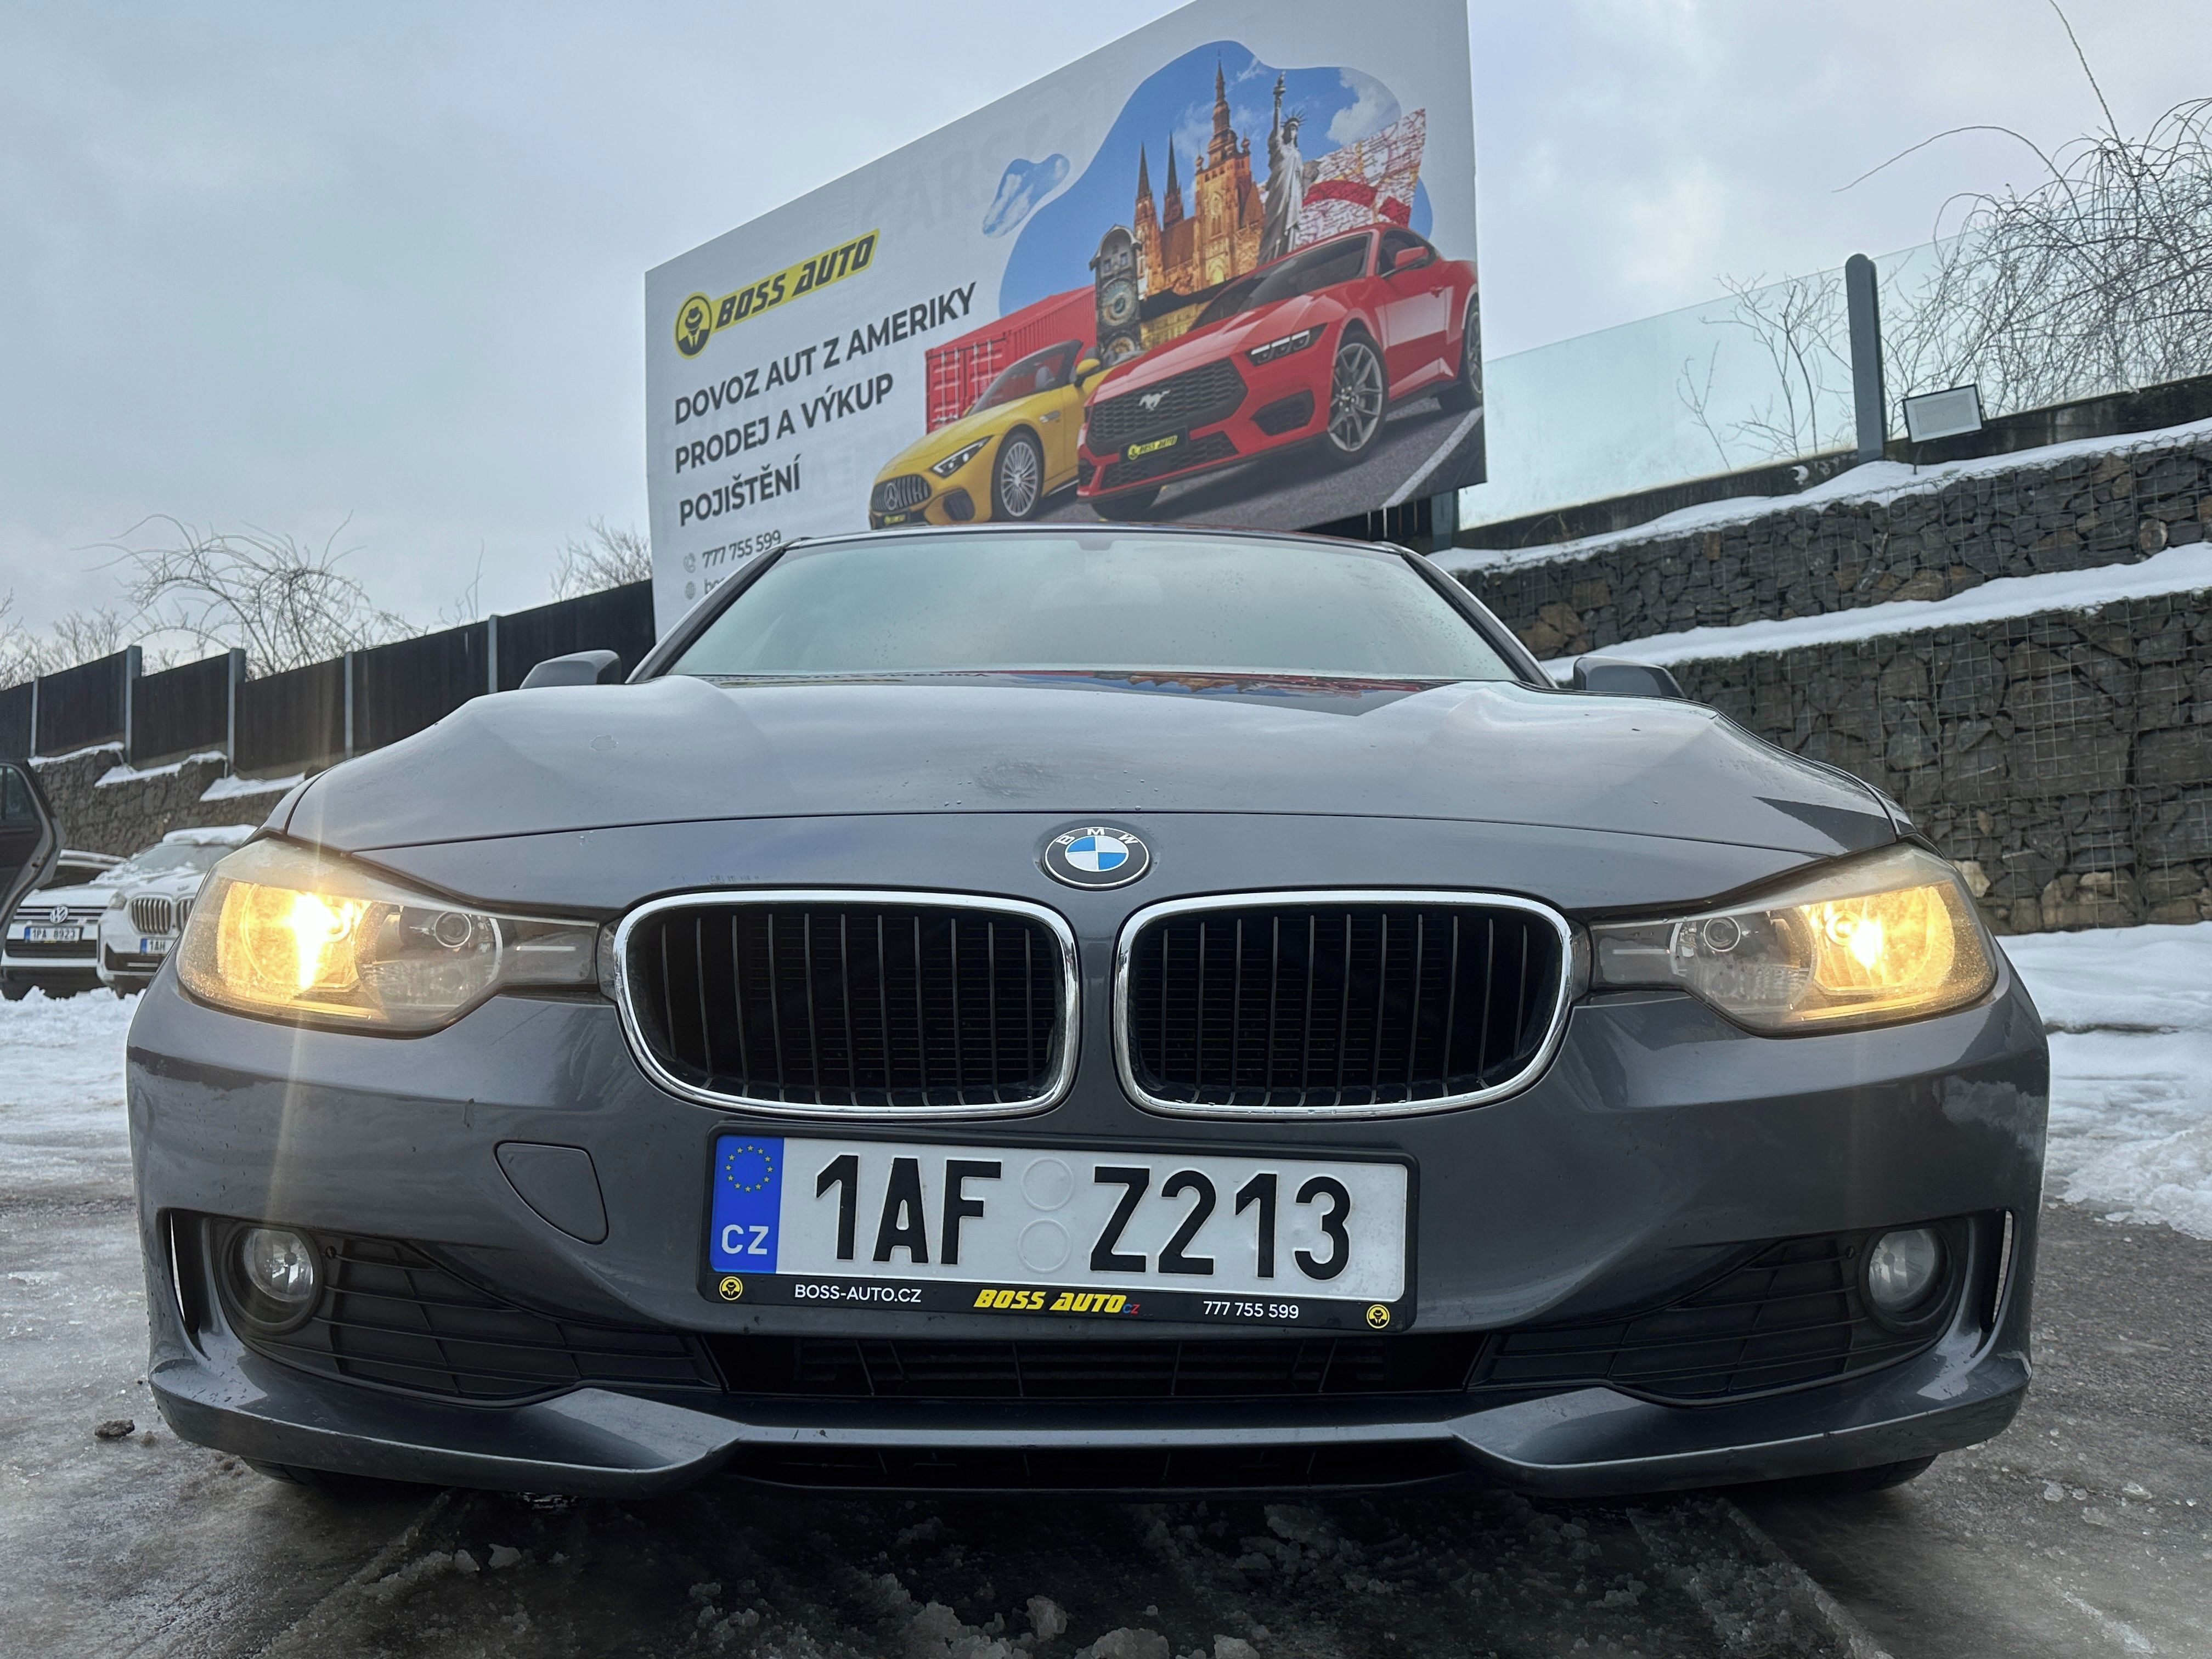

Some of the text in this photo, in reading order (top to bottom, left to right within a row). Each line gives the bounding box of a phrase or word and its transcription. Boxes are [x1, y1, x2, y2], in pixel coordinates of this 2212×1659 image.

[715, 234, 876, 329] BOSS AUTO
[675, 281, 977, 425] DOVOZ AUT Z AMERIKY
[675, 373, 894, 474] PRODEJ A VÝKUP
[680, 453, 802, 527] POJIŠTĚNÍ
[702, 529, 782, 568] 777 755 599
[1055, 828, 1139, 845] BMW
[816, 1155, 1351, 1280] 1AF Z213
[721, 1224, 769, 1255] CZ
[794, 1284, 922, 1303] BOSS-AUTO.CZ
[973, 1289, 1045, 1310] BOSS
[1049, 1293, 1127, 1313] AUTO
[1203, 1301, 1299, 1319] 777 755 599
